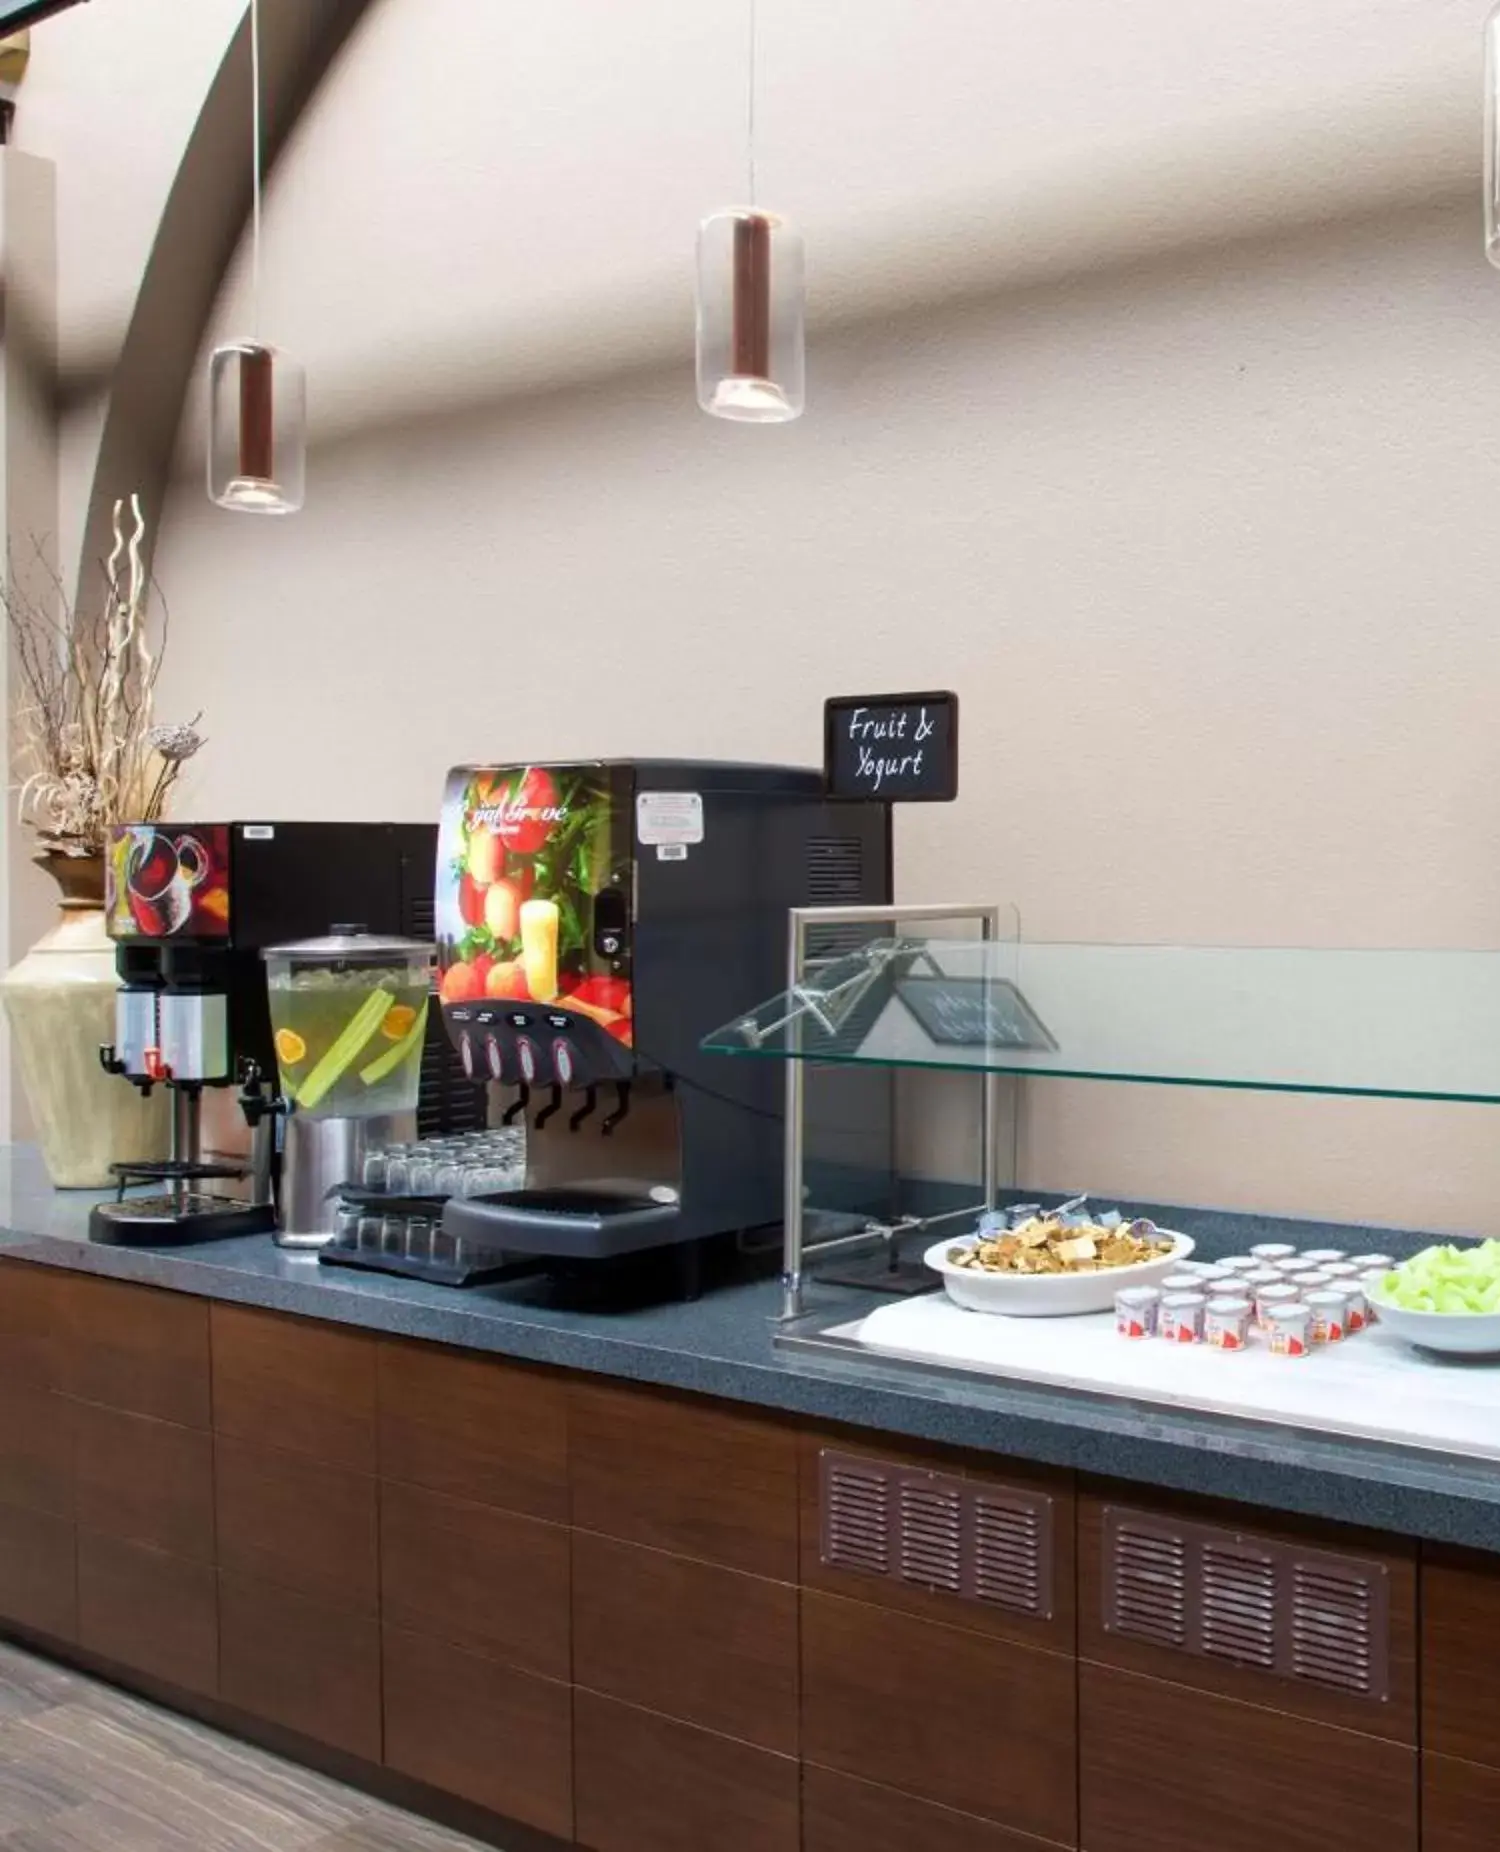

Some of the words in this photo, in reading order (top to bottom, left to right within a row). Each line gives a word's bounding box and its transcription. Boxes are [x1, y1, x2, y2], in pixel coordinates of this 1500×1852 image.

[850, 708, 906, 739] Fruit
[914, 708, 934, 741] &
[856, 747, 922, 790] Yogurt
